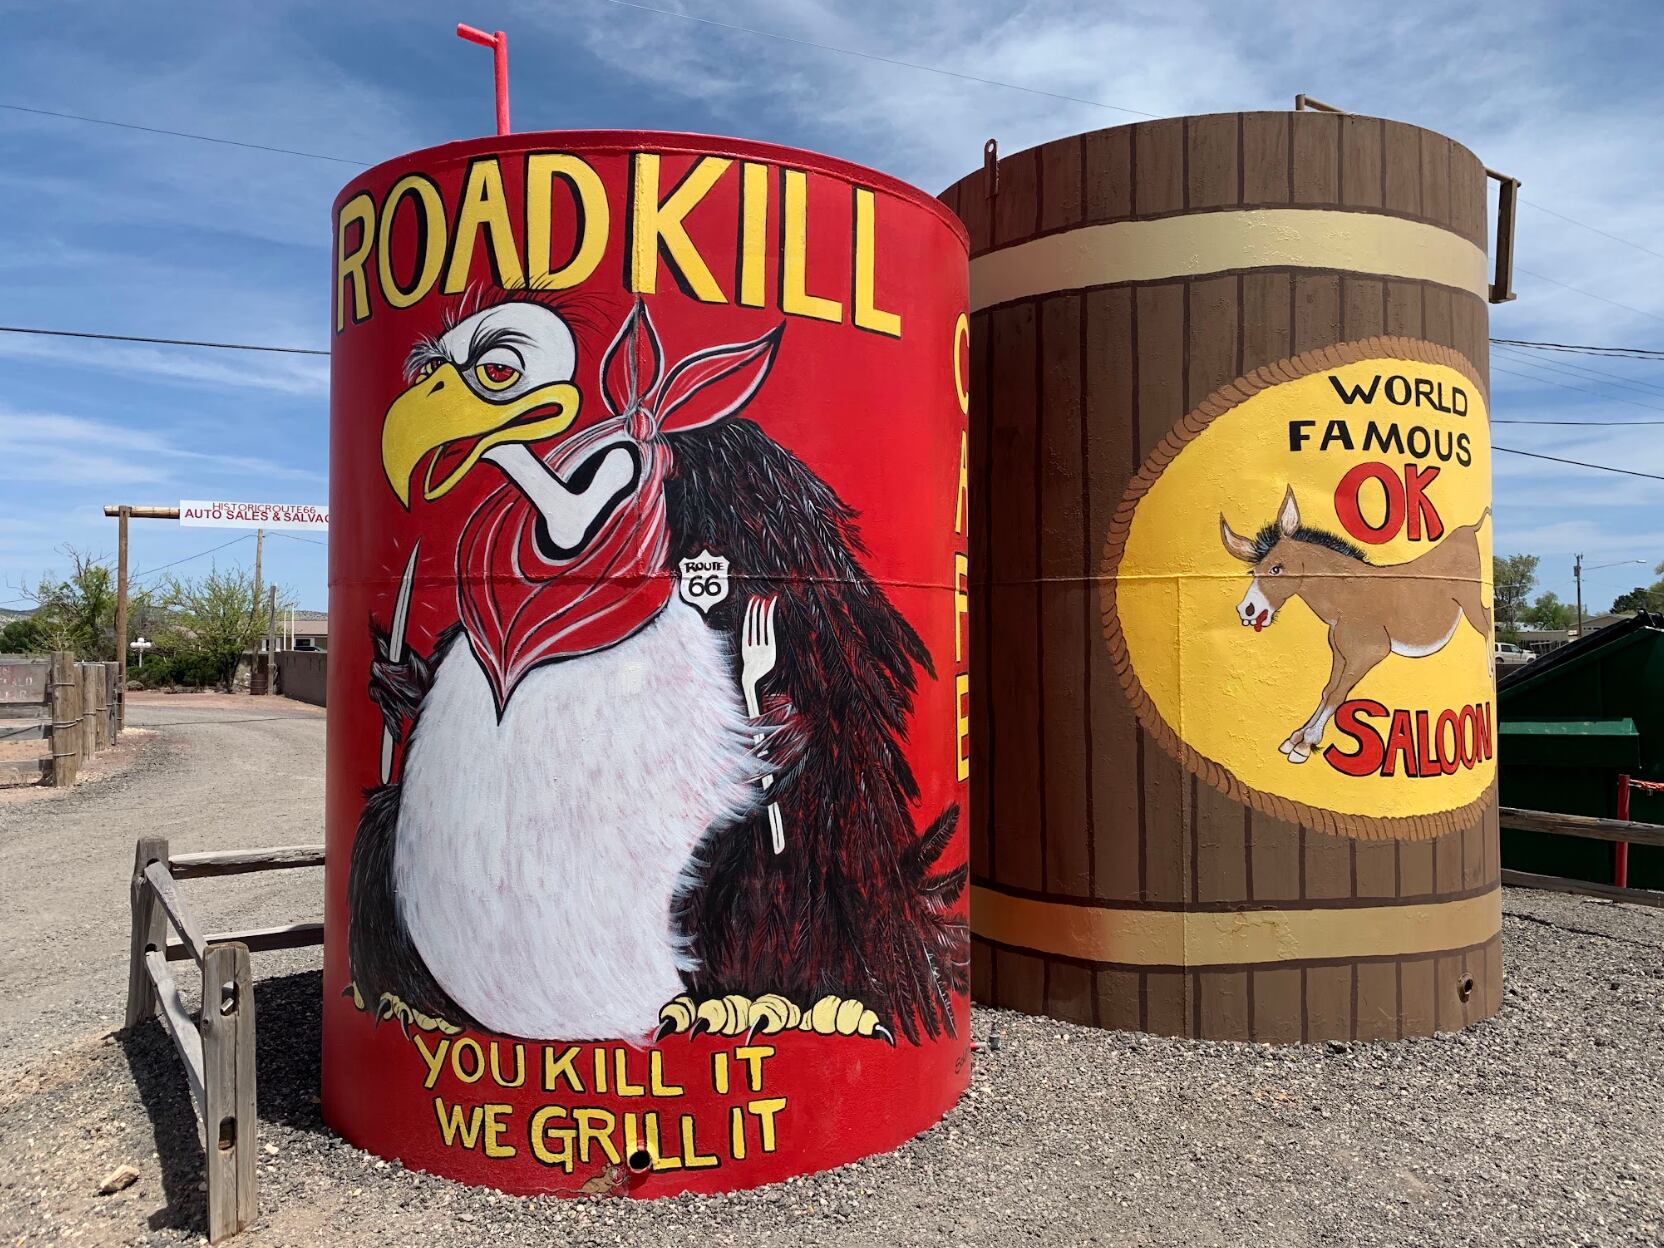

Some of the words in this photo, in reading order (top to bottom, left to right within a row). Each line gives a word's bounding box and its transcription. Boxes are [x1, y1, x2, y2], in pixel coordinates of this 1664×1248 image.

[1328, 375, 1468, 417] WORLD
[1289, 420, 1472, 467] FAMOUS
[185, 508, 222, 519] AUTO
[226, 511, 269, 522] SALES
[272, 512, 281, 522] &
[1334, 461, 1444, 545] OK
[684, 561, 724, 573] ROUTE
[688, 574, 722, 597] 66
[1323, 698, 1493, 778] SALOON
[412, 1034, 527, 1090] YOU
[541, 1045, 684, 1098] KILL
[711, 1045, 776, 1095] IT
[433, 1097, 517, 1158] WE
[528, 1104, 719, 1174] GRILL
[729, 1097, 787, 1160] IT
